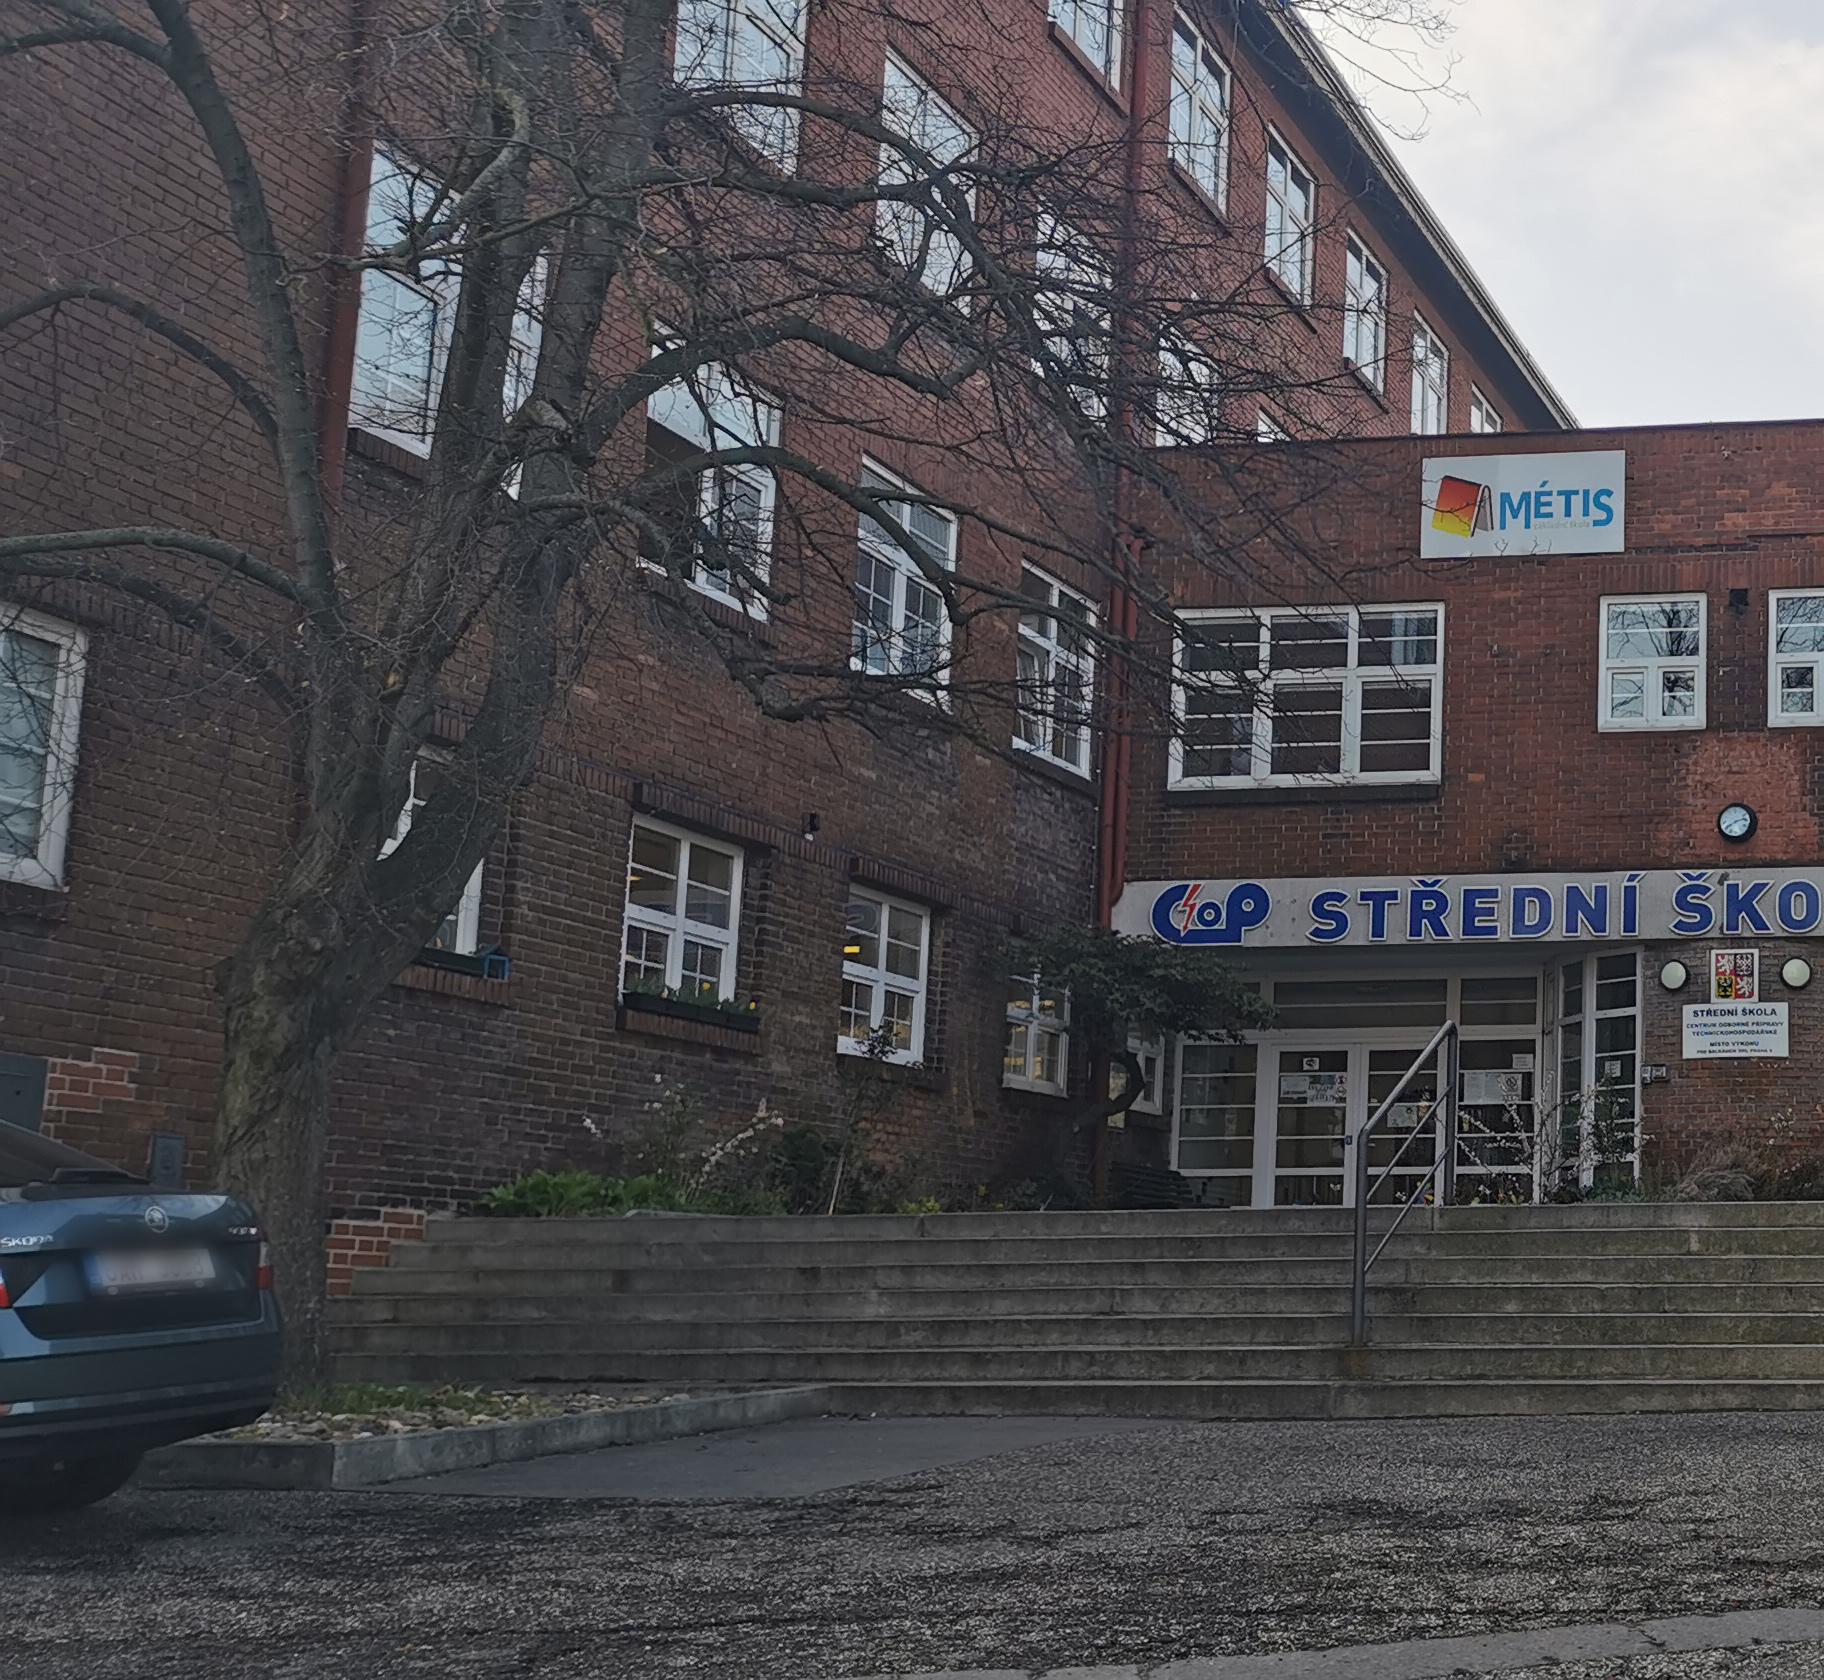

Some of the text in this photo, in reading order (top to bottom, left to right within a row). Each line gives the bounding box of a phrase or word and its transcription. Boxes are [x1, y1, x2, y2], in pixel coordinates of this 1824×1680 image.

[1500, 480, 1614, 530] MÉTIS
[1306, 873, 1648, 942] STŘEDNÍ
[1692, 1006, 1777, 1017] STŘEDNÍ ŠKOLA
